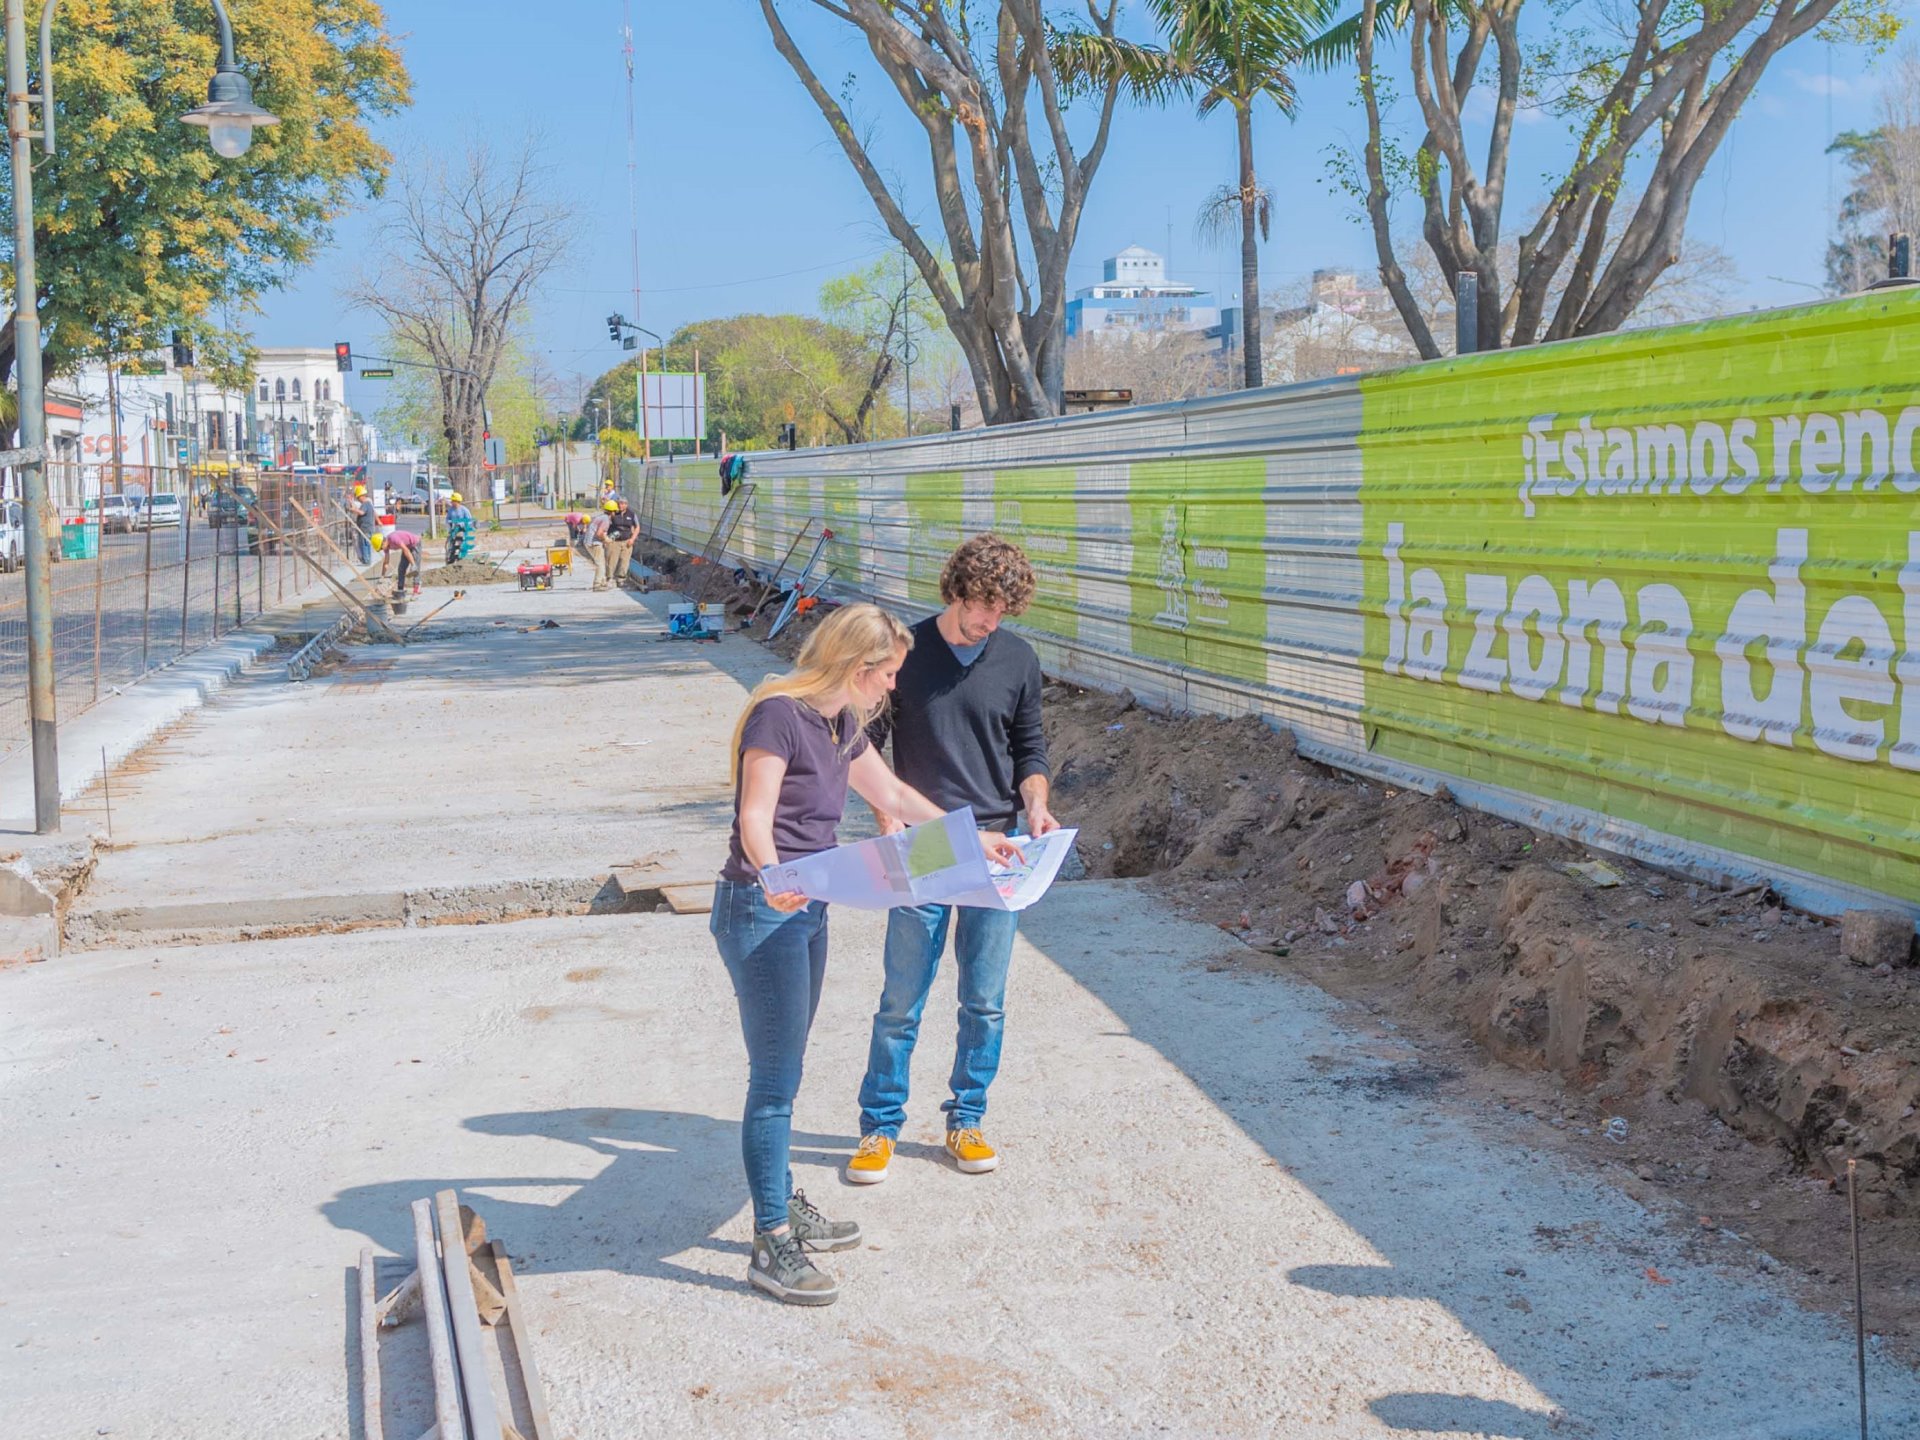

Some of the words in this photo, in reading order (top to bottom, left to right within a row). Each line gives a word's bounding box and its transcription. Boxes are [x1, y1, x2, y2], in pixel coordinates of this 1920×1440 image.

[1518, 412, 1759, 517] ¡Estamos
[1383, 522, 1448, 683] la
[1457, 574, 1694, 728] zona
